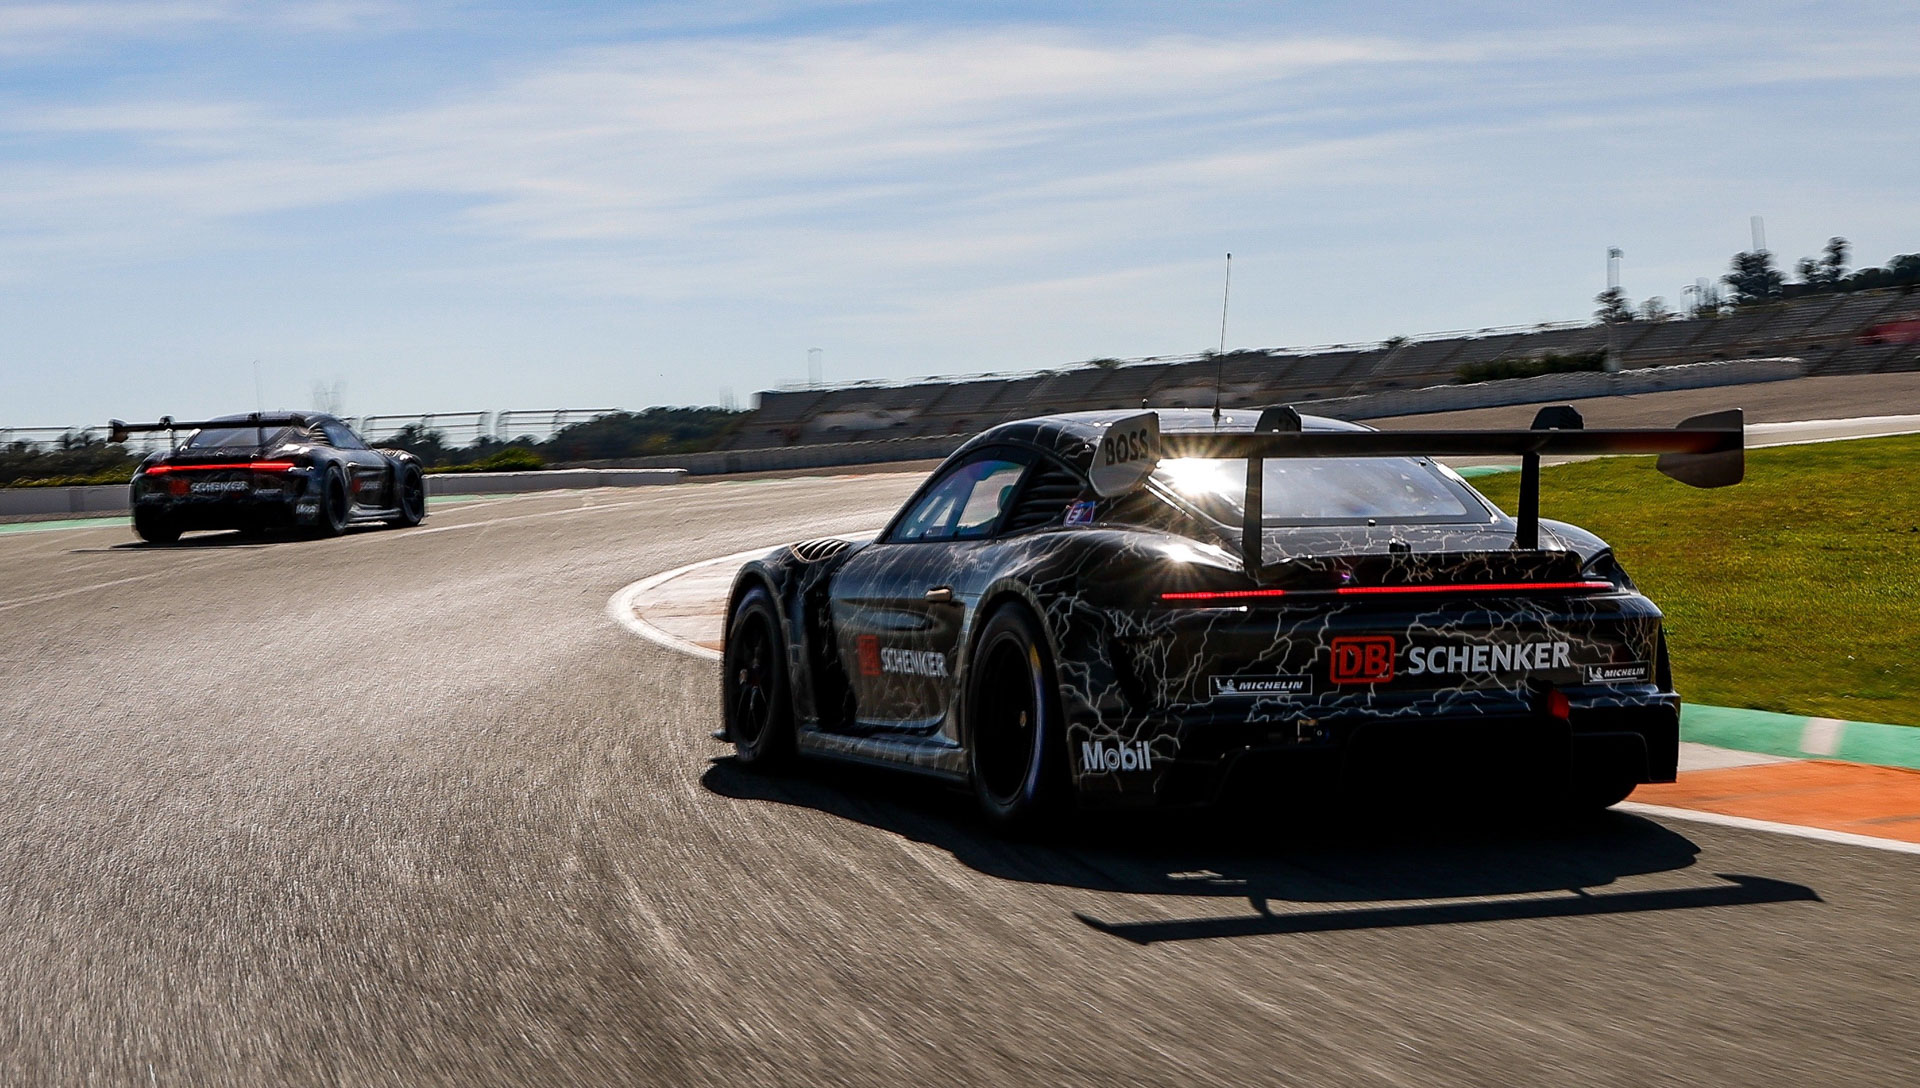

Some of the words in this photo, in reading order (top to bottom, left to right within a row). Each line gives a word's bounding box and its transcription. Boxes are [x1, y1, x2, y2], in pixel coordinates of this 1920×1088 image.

[1105, 428, 1149, 466] BOSS
[881, 647, 949, 678] SCHENKER
[1339, 643, 1389, 676] DB
[1408, 641, 1571, 675] SCHENKER
[1603, 666, 1646, 679] MICHELIN
[1239, 680, 1304, 691] MICHELIN
[1082, 741, 1152, 770] Mobil
